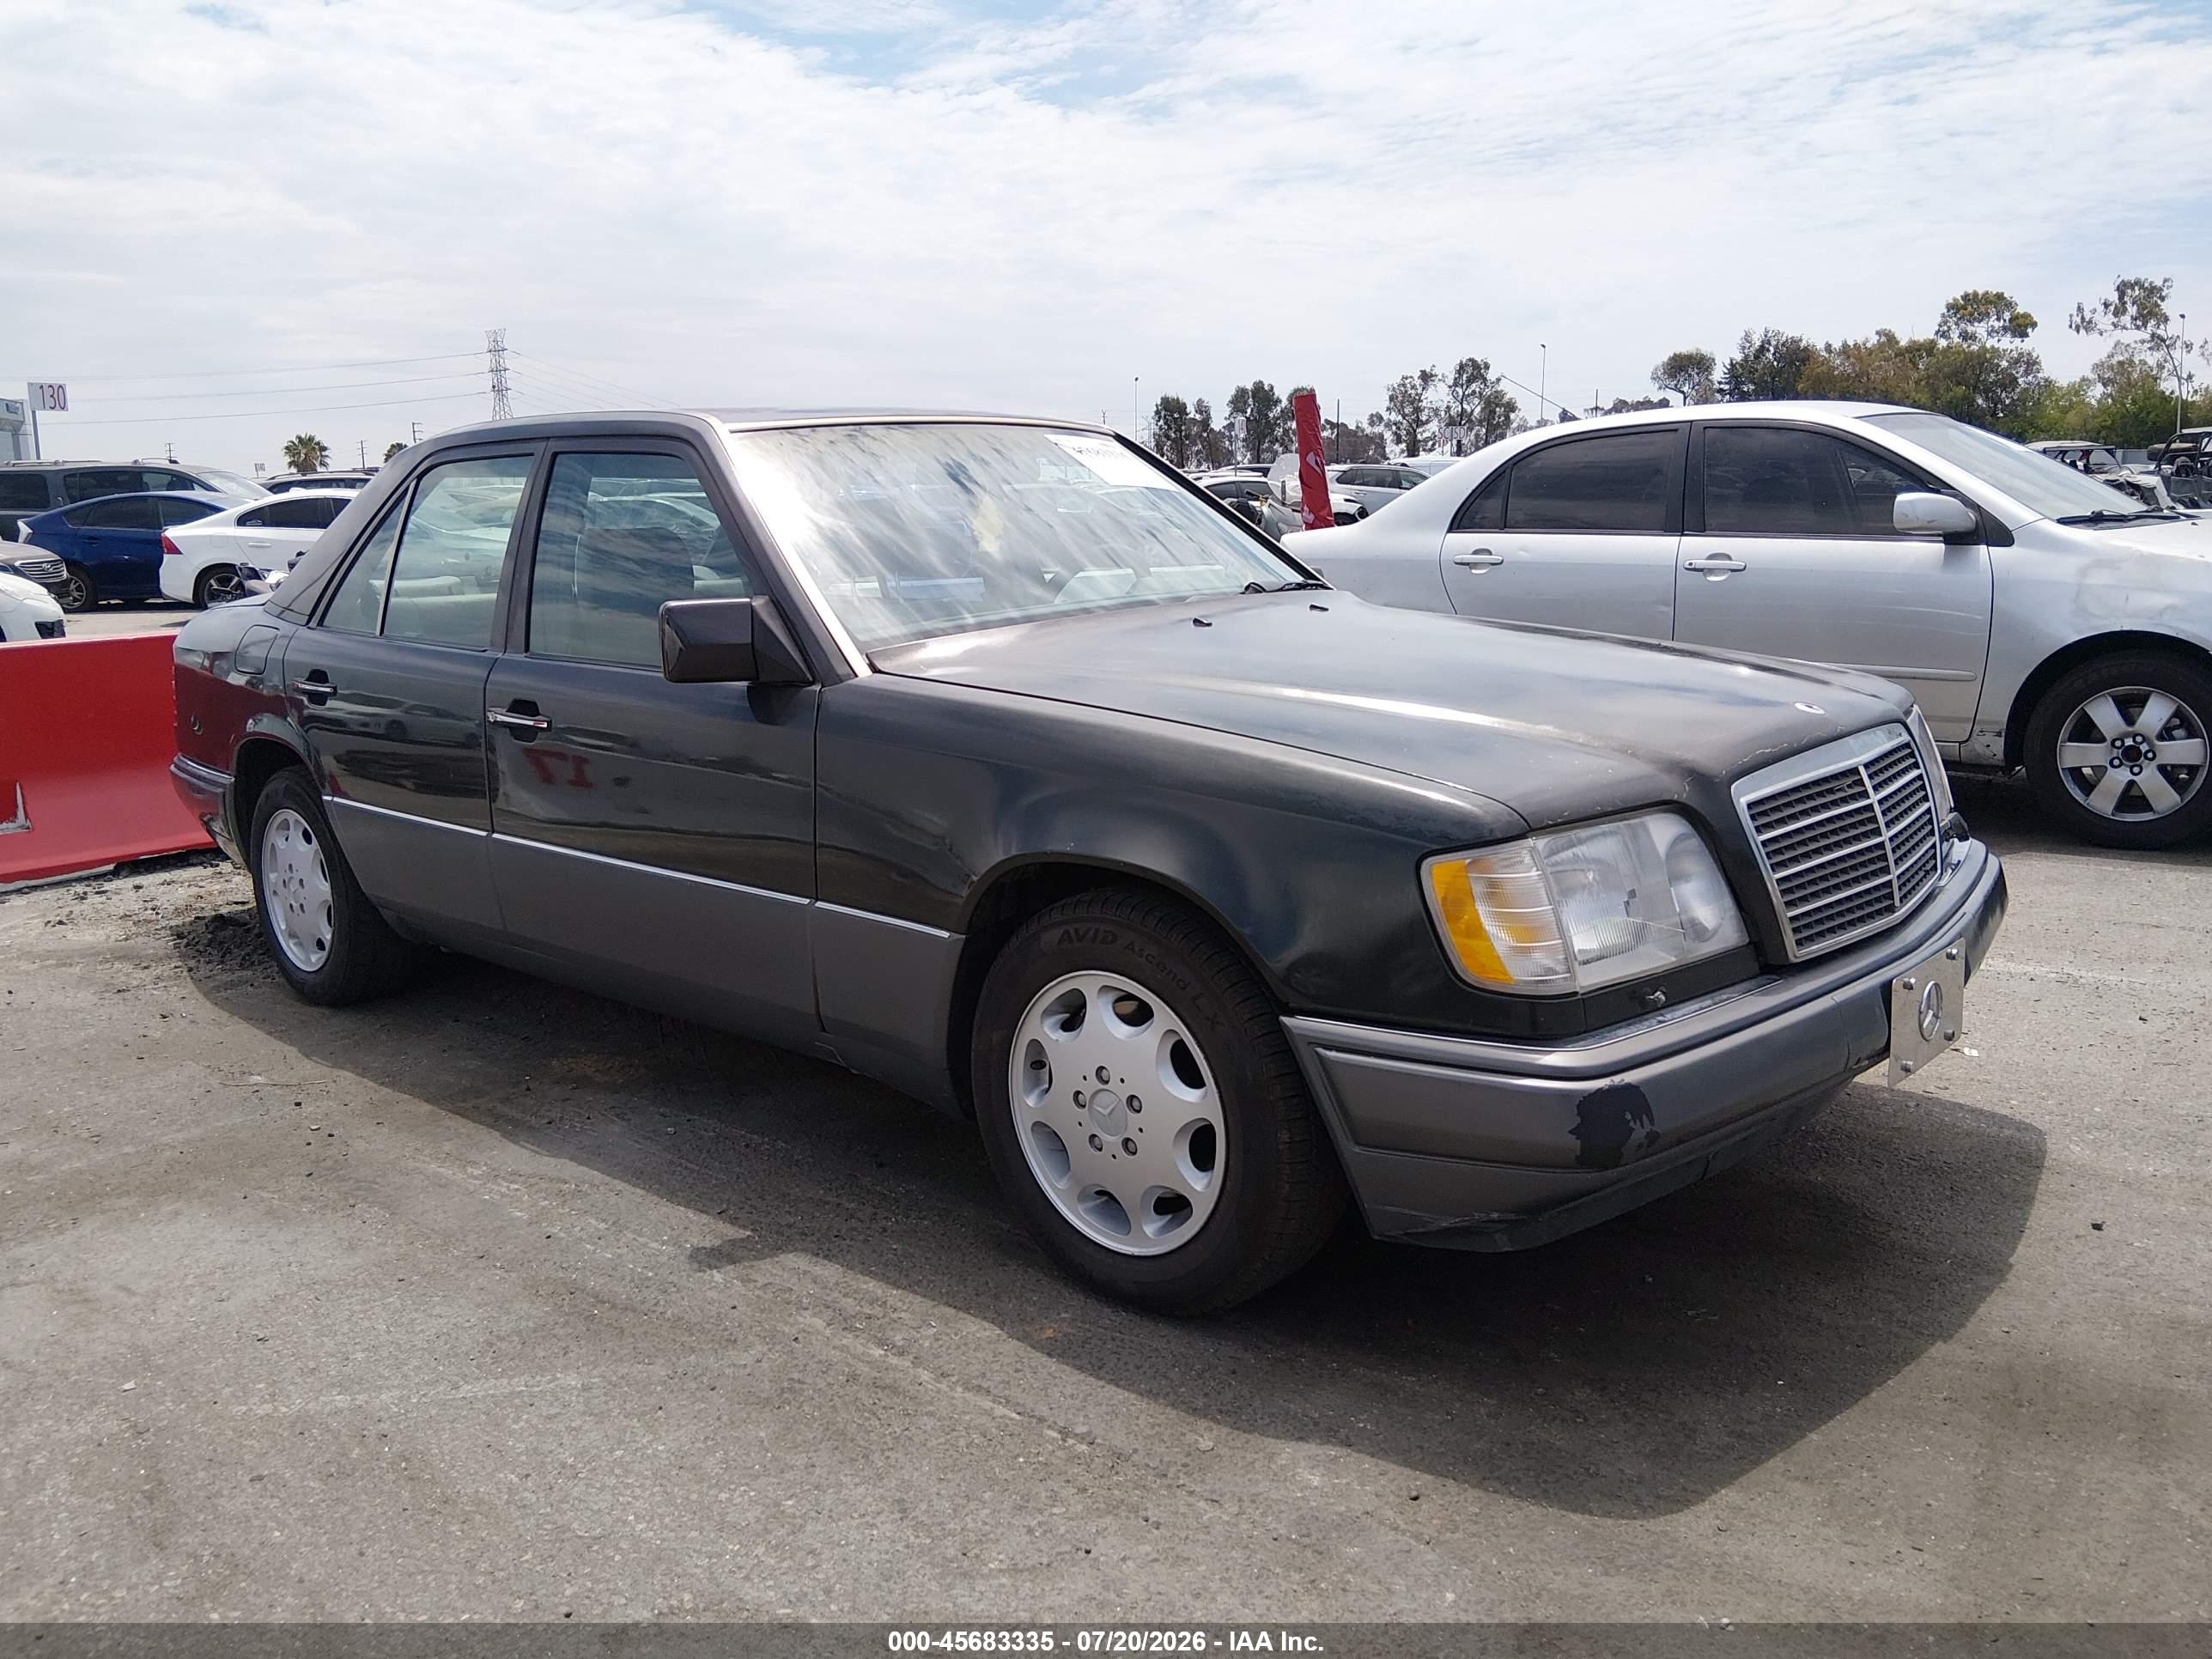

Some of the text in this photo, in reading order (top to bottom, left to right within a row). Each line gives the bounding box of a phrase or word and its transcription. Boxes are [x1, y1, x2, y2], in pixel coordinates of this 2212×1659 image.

[39, 384, 67, 410] 130
[1057, 926, 1118, 947] AVID
[1123, 940, 1192, 991] Ascend
